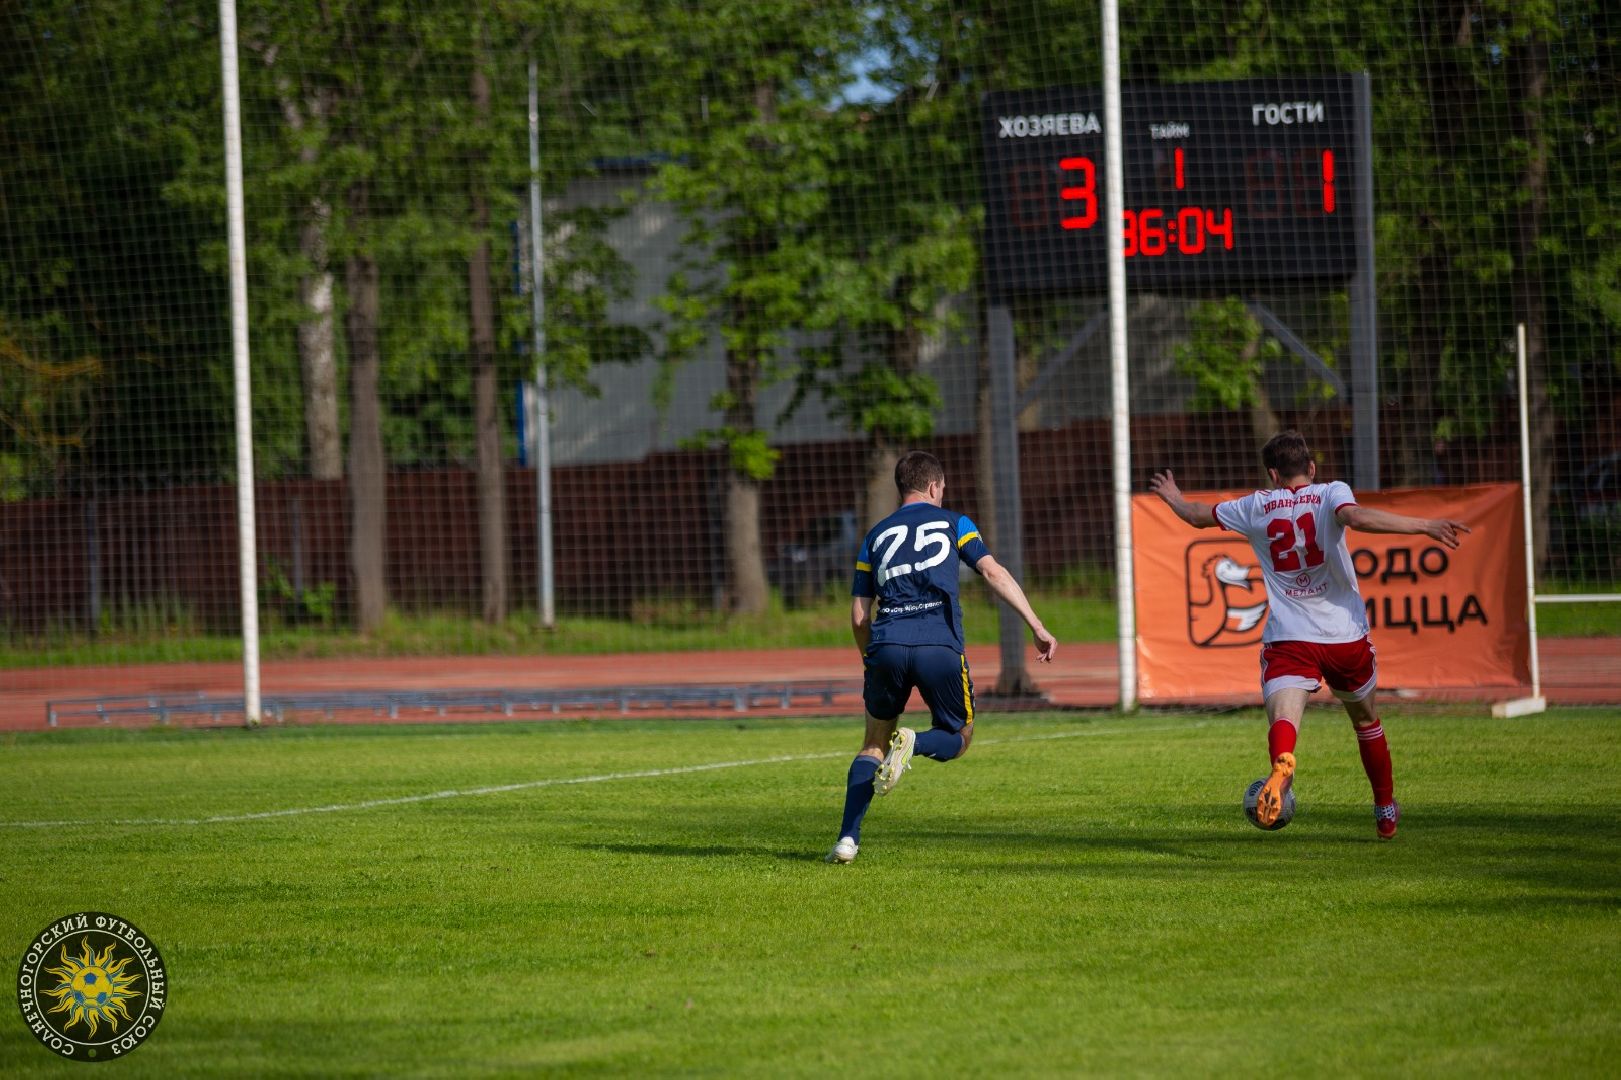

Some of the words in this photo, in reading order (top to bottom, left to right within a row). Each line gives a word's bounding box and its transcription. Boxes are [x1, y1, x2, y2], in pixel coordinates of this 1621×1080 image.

[998, 111, 1102, 139] ХОЗЯЕВА
[1252, 101, 1325, 126] ГОСТИ
[1173, 146, 1185, 190] 1
[1321, 147, 1336, 215] 1
[1058, 156, 1099, 230] 3
[872, 520, 951, 587] 25
[1266, 512, 1325, 572] 21
[1351, 546, 1449, 584] ОДО
[1365, 594, 1488, 634] ЦЦА
